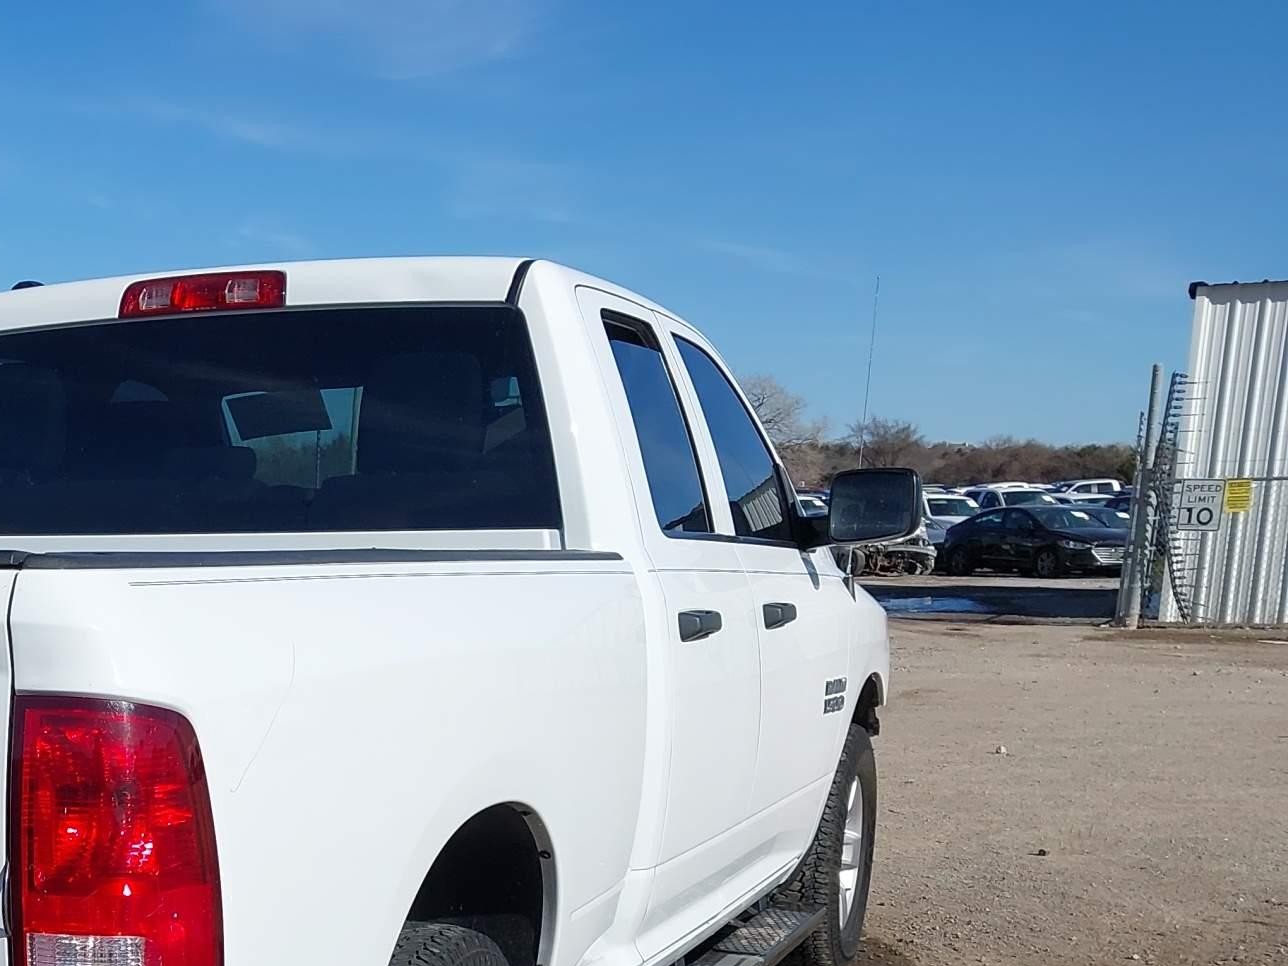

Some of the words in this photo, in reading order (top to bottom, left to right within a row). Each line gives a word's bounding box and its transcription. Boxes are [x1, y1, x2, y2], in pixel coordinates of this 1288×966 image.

[1185, 484, 1223, 493] SPEED
[1187, 495, 1217, 504] LIMIT
[1186, 507, 1214, 526] 10
